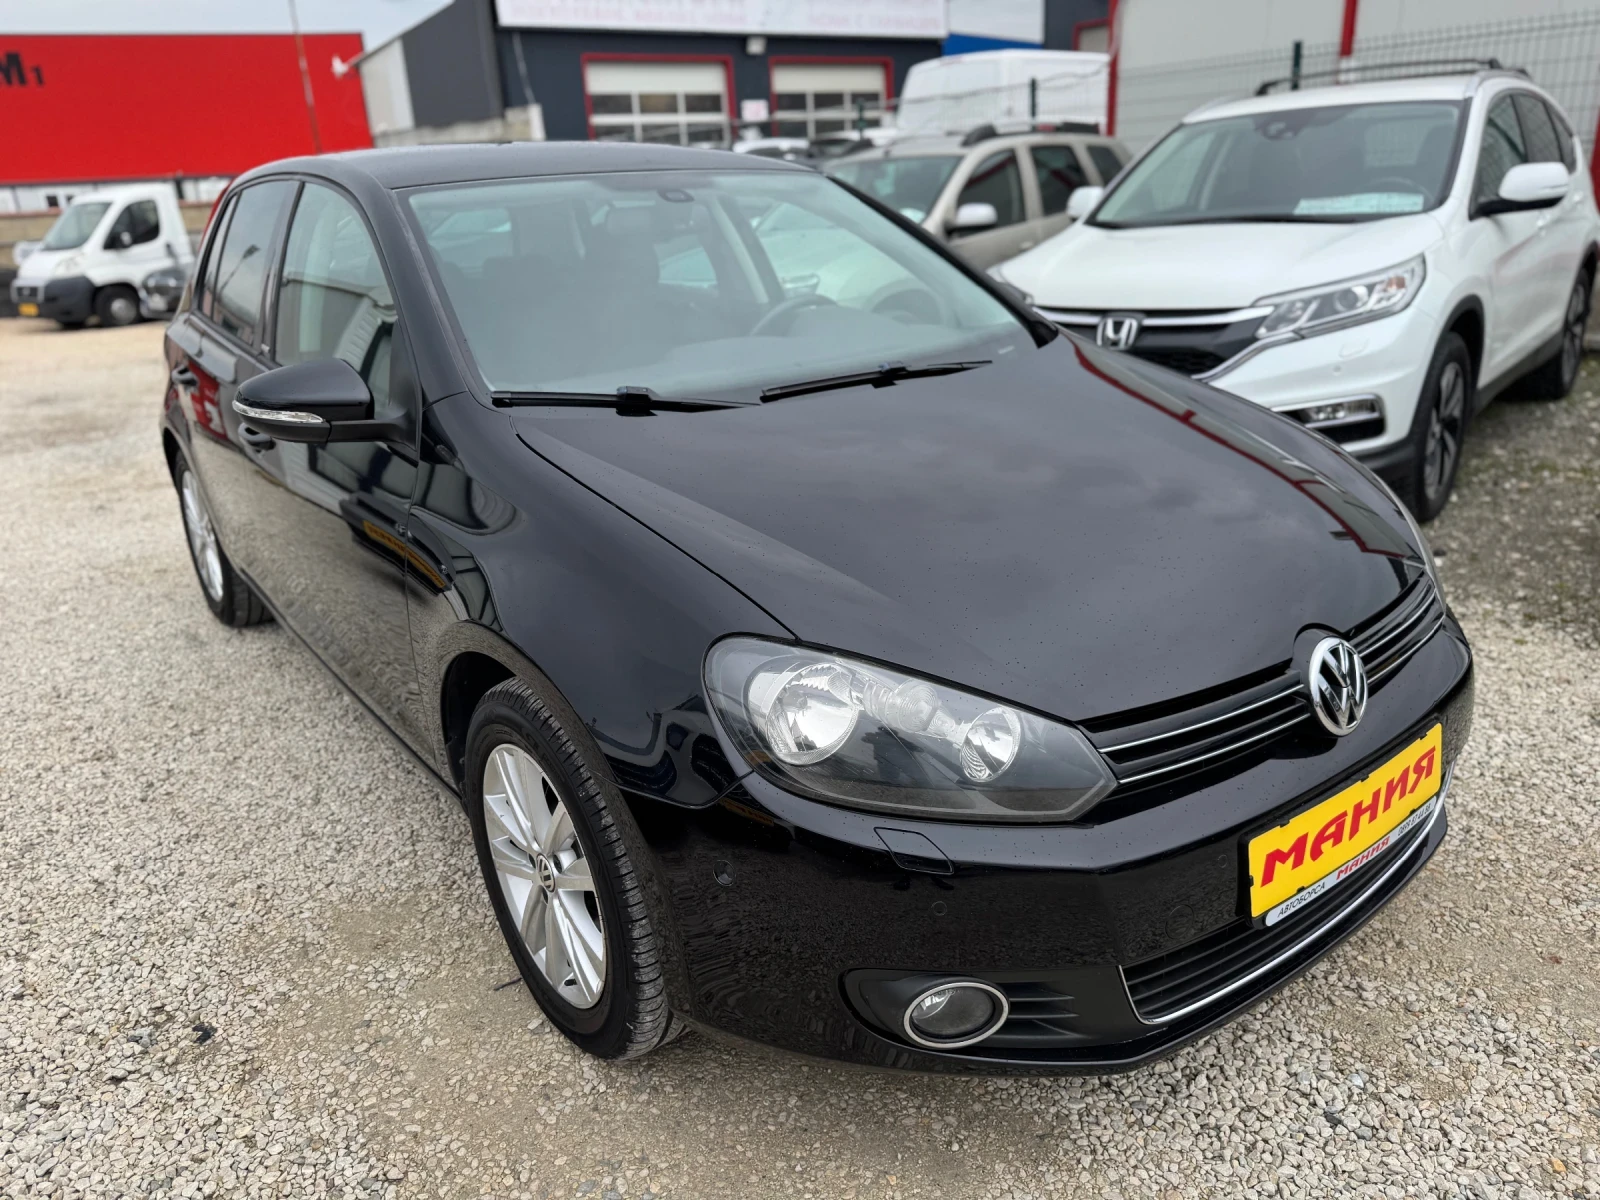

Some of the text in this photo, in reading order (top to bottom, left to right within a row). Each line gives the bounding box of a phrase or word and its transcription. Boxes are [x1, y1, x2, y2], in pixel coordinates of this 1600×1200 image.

[1260, 746, 1436, 888] МАНИЯ
[1277, 882, 1326, 918] АВТОБОРСА
[1336, 835, 1391, 880] МАНИЯ
